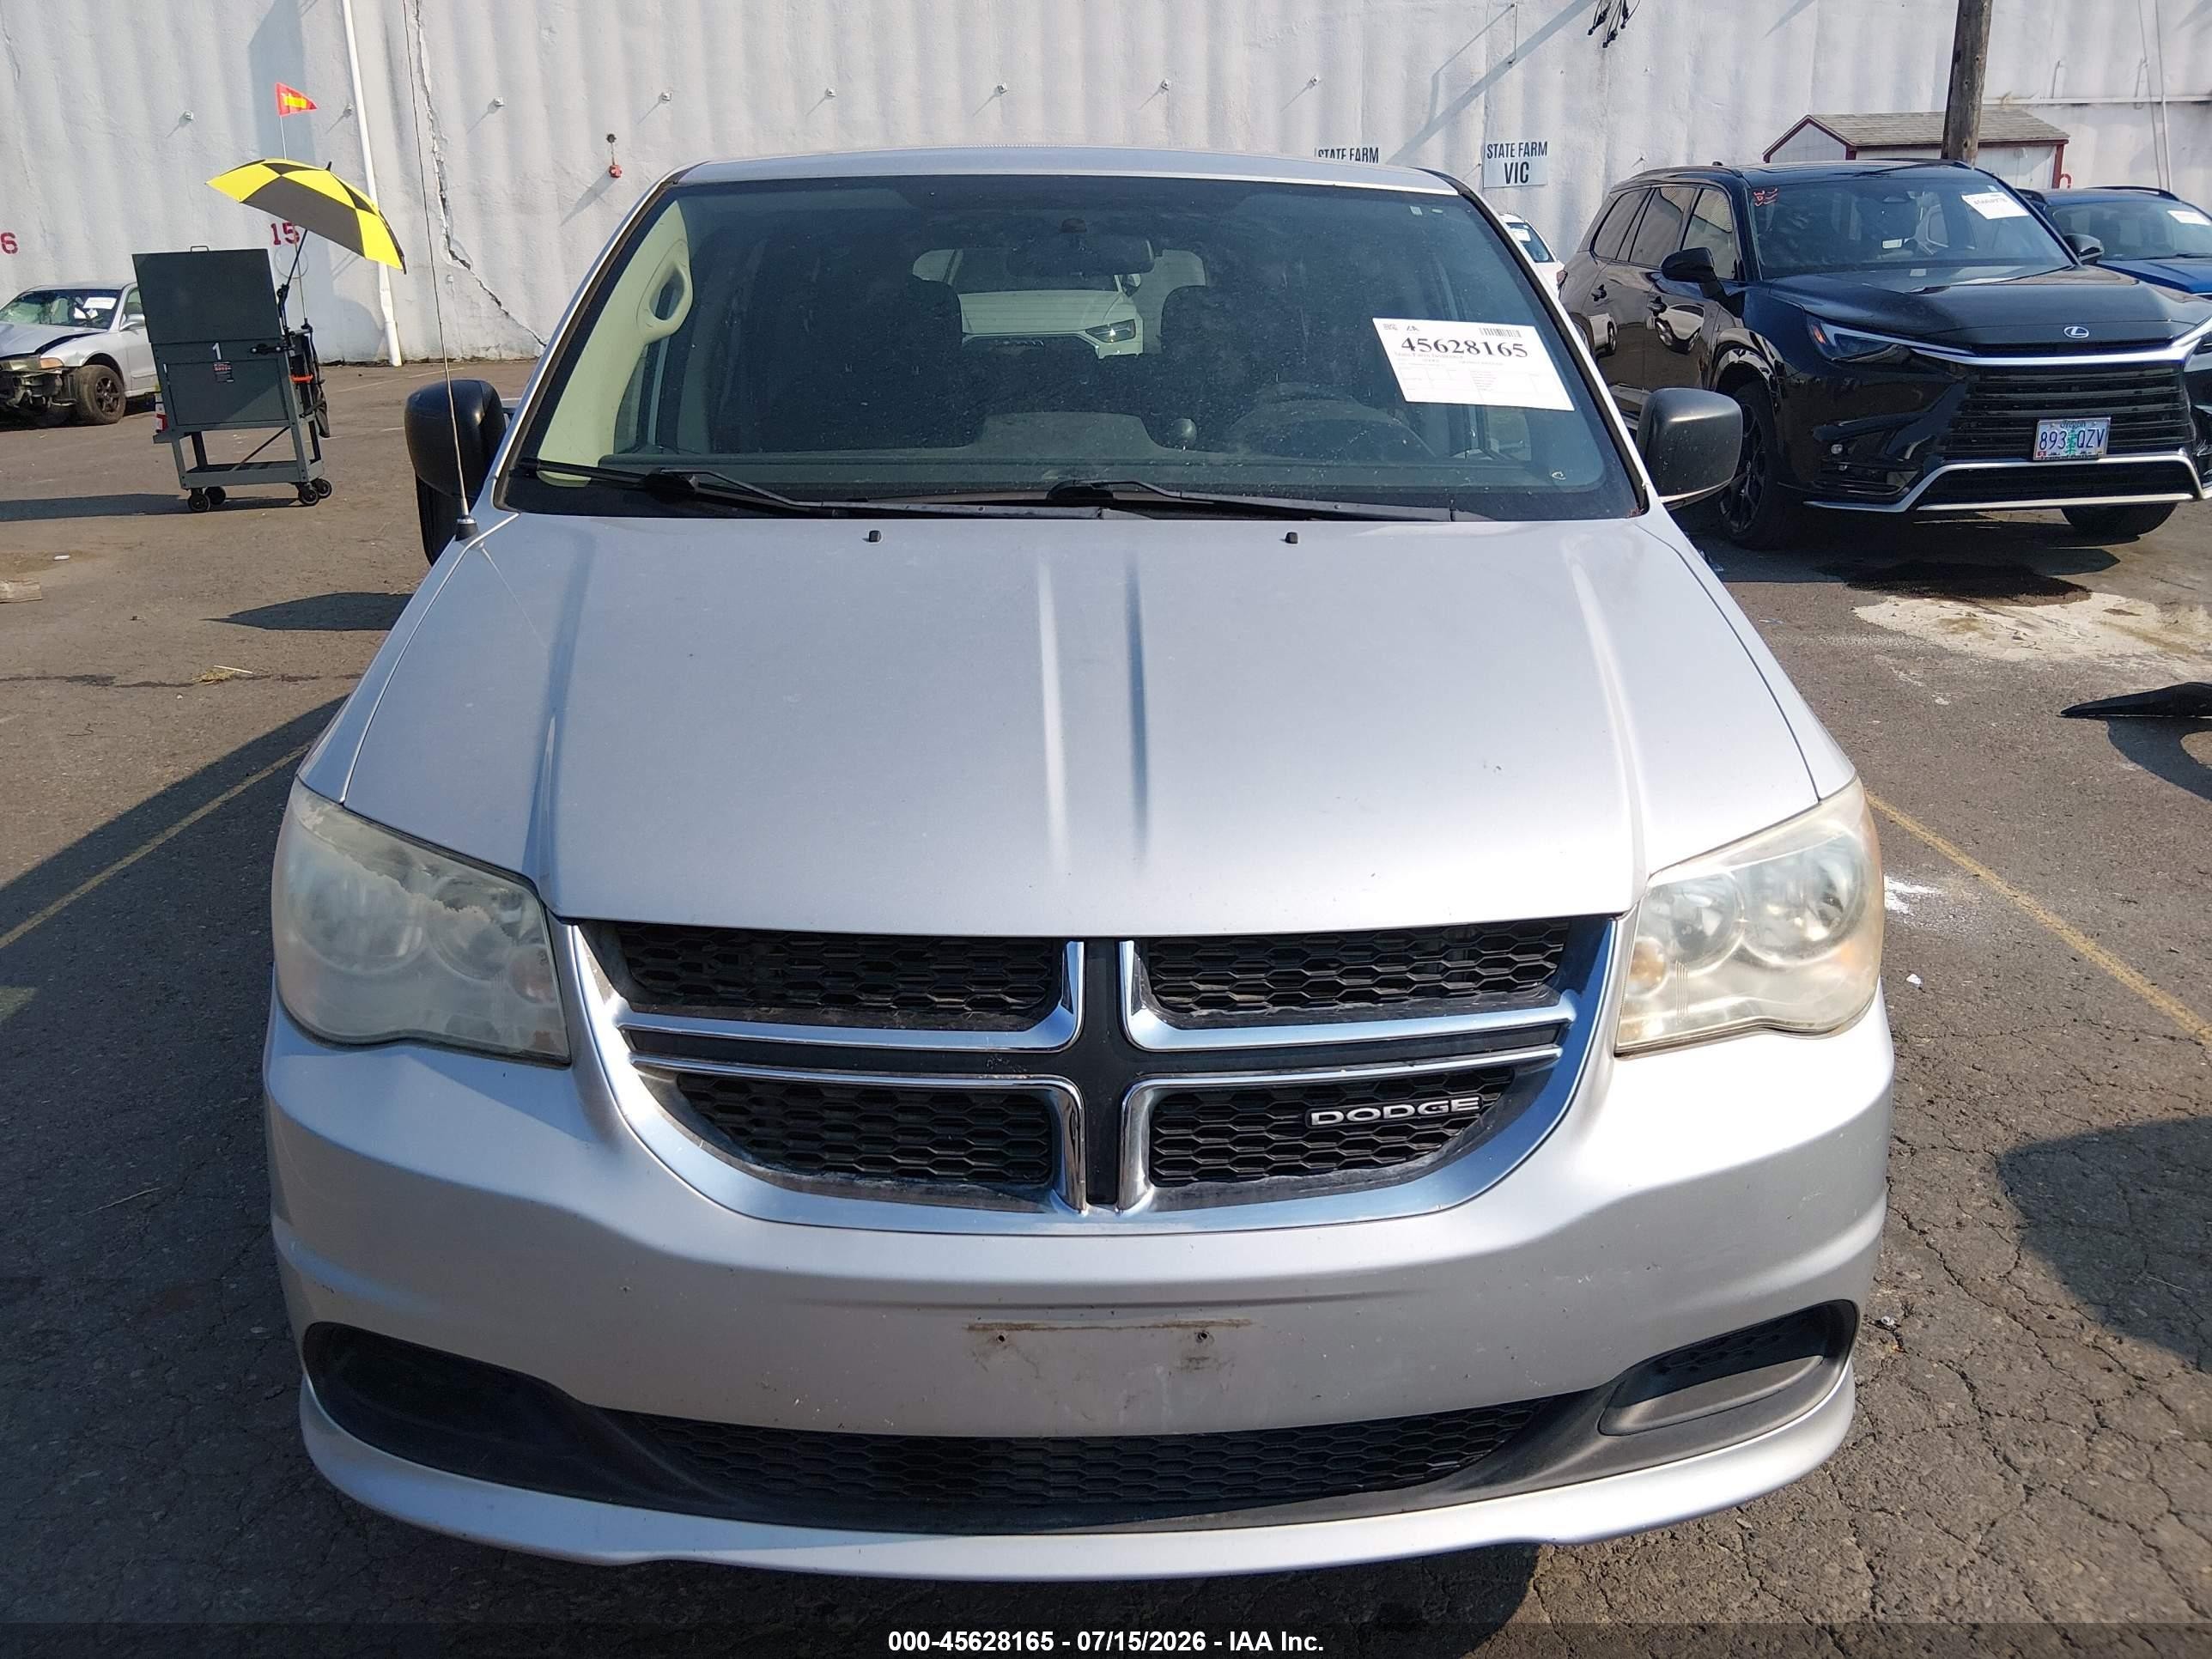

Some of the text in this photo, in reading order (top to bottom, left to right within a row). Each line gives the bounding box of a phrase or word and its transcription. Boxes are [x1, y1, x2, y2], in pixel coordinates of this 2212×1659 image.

[1349, 147, 1379, 164] FARM
[1486, 141, 1548, 160] STATE FARM
[1504, 161, 1529, 185] VIC
[0, 232, 19, 254] 6
[270, 221, 301, 246] 15
[212, 342, 222, 361] 1
[1401, 336, 1528, 358] 45628165
[2059, 420, 2087, 429] Oregon
[2039, 429, 2106, 450] 893 QZV
[1310, 1096, 1480, 1127] DODGE
